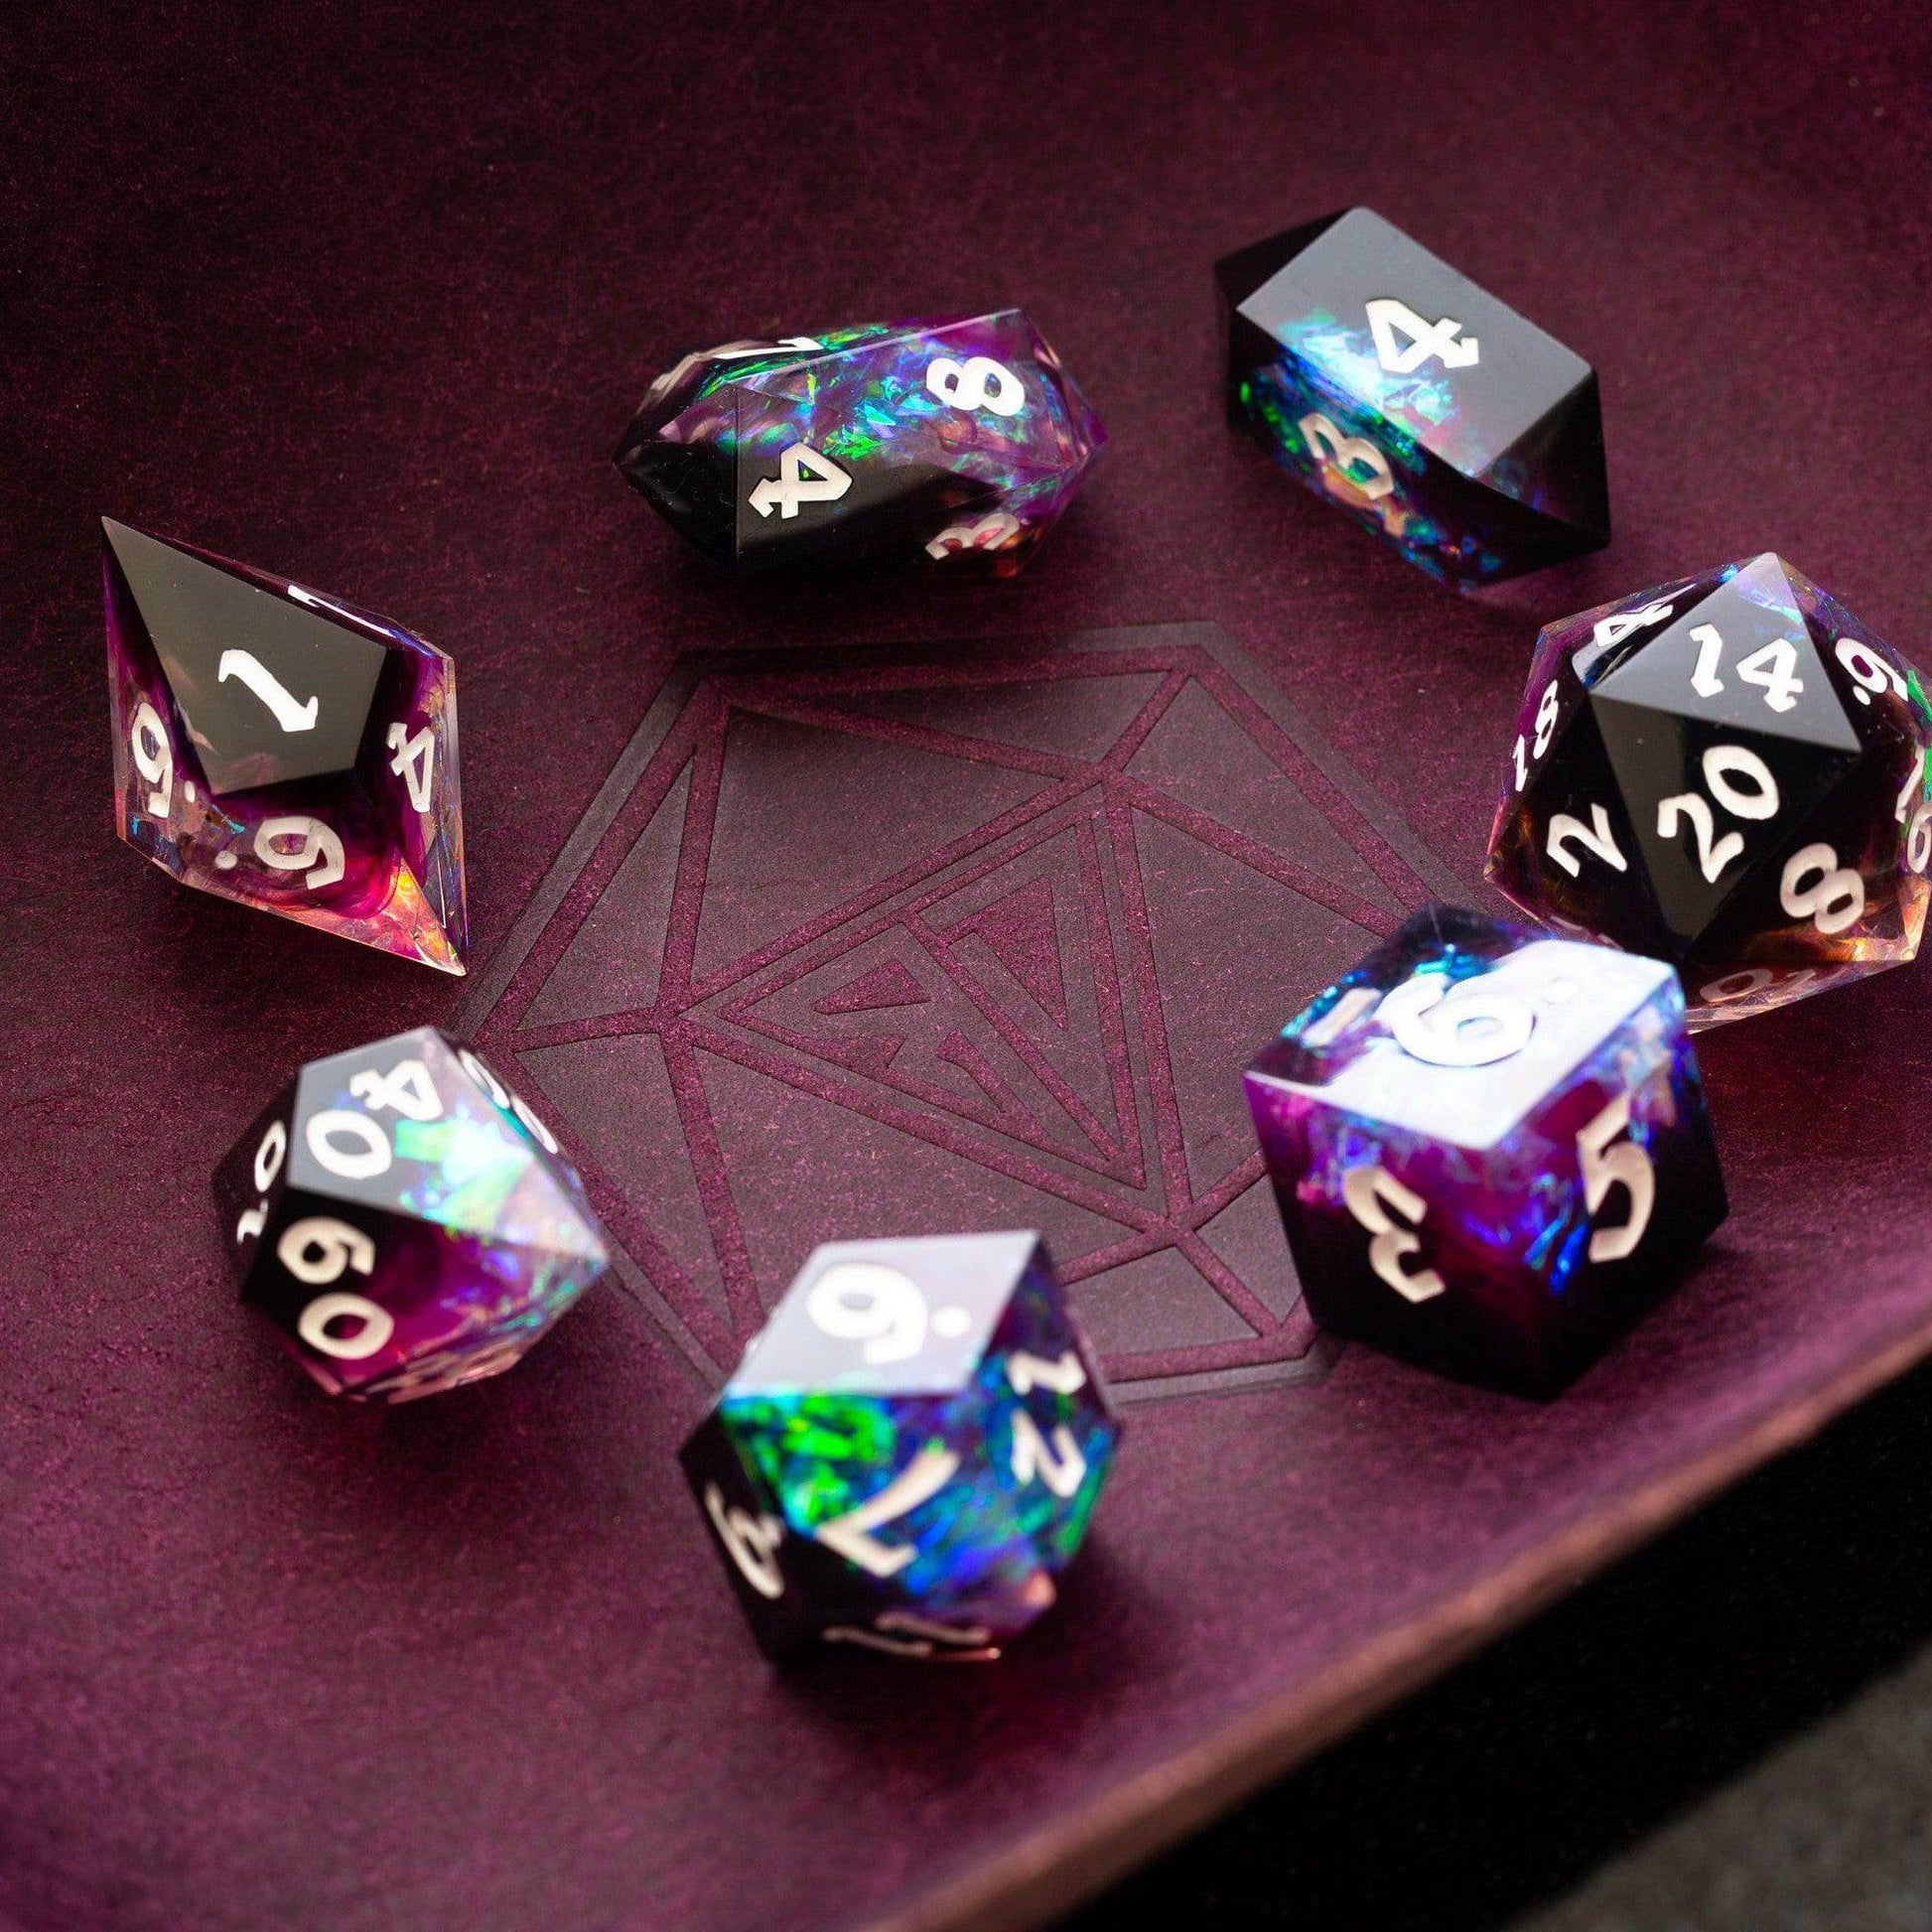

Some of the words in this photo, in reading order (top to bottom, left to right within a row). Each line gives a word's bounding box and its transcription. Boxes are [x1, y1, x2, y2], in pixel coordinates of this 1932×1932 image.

[1365, 298, 1479, 373] 4
[925, 356, 1026, 416] 8
[748, 442, 853, 519] 4
[1593, 604, 1674, 647] 4
[1689, 622, 1804, 713] 14
[217, 648, 318, 732] 1
[1512, 679, 1559, 792] 18
[386, 722, 435, 812] 4
[1546, 802, 1627, 878] 2
[1657, 745, 1779, 883] 20
[1779, 842, 1865, 935] 8
[306, 1059, 444, 1179] 40
[1576, 1094, 1655, 1264] 5
[1341, 1166, 1446, 1305] 3
[1006, 1348, 1088, 1498] 12
[814, 1449, 961, 1579] 7
